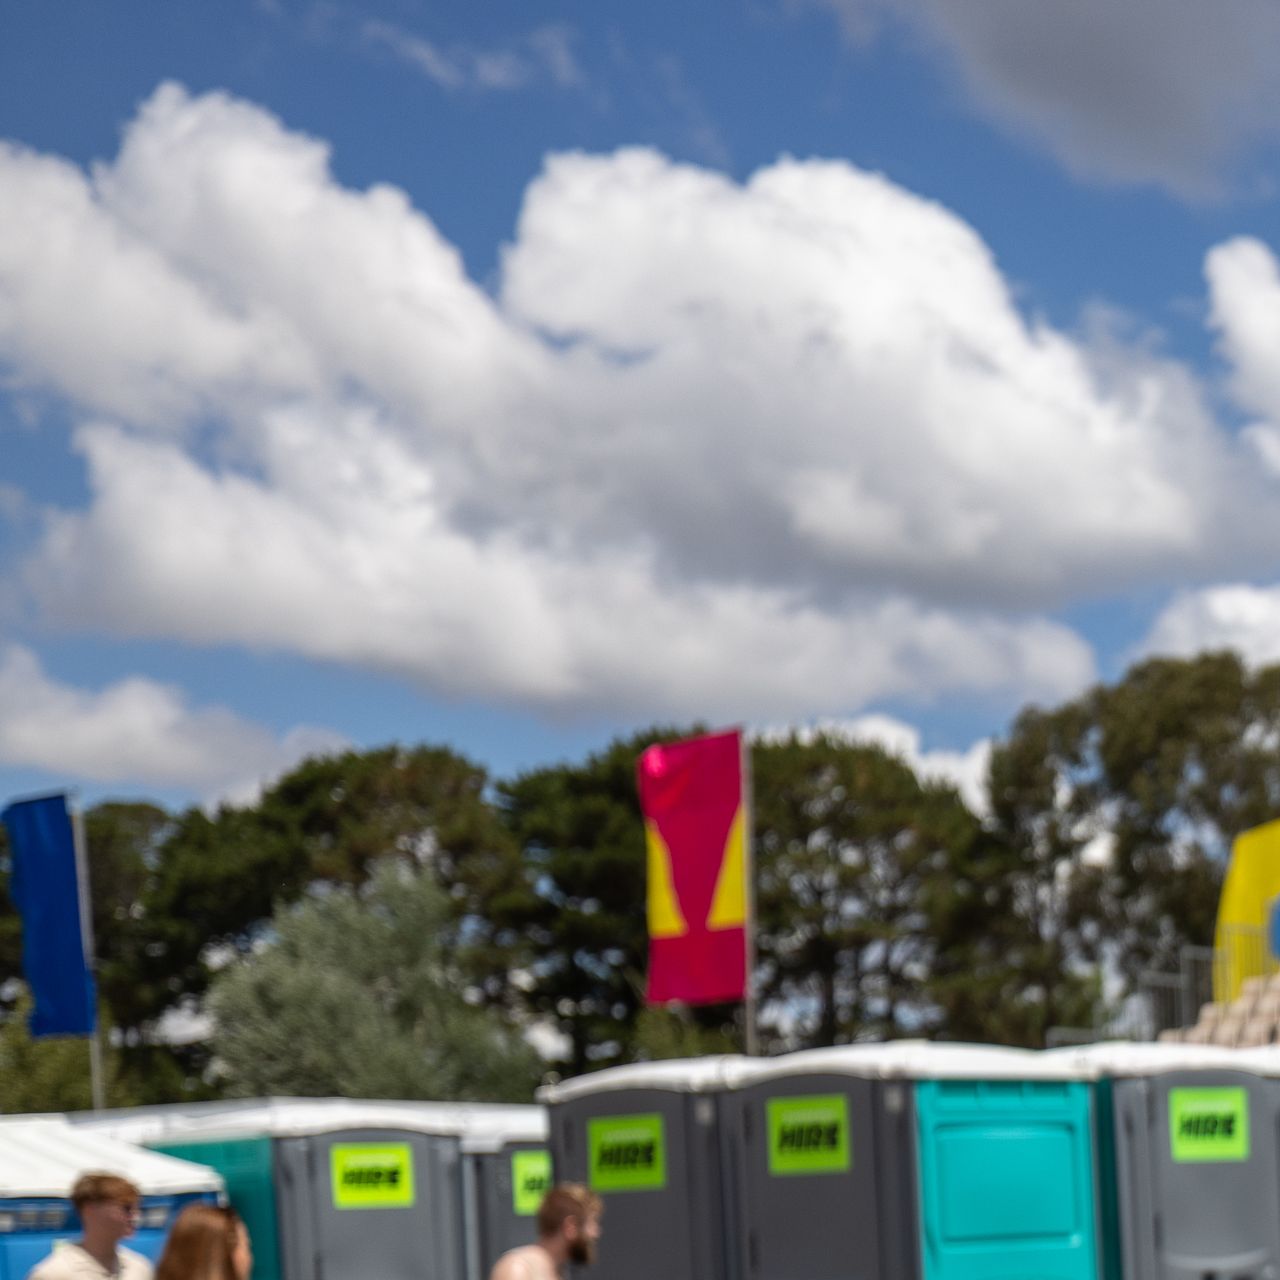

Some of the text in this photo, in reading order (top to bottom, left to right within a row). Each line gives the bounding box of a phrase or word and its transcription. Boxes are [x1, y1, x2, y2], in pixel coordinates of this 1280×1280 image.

[778, 1122, 840, 1152] HIRE
[1180, 1114, 1236, 1139] HIRE
[598, 1140, 656, 1171] HIRE
